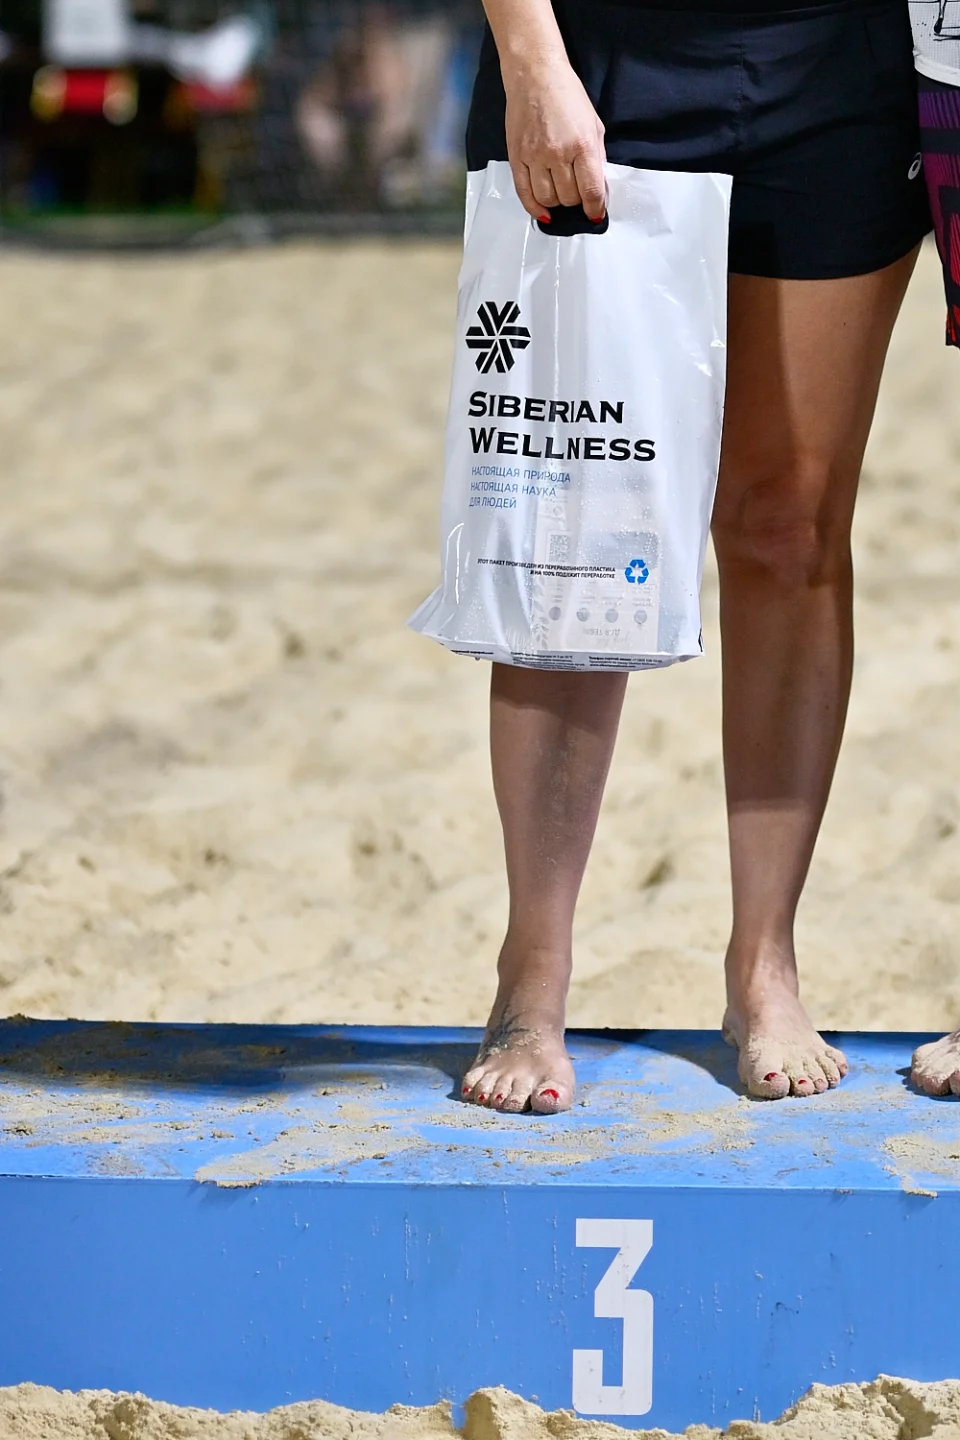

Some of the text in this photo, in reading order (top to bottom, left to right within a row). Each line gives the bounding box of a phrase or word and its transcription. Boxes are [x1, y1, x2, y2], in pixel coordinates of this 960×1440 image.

[468, 390, 625, 423] SIBERIAN
[469, 427, 656, 461] WELLNESS
[471, 466, 571, 483] НАСТОЯЩАЯ ПРИРОДА
[470, 481, 557, 497] НАСТОЯЩАЯ НАУКА
[469, 496, 517, 509] ДЛЯ ЛЮДЕЙ
[572, 1218, 654, 1416] 3
